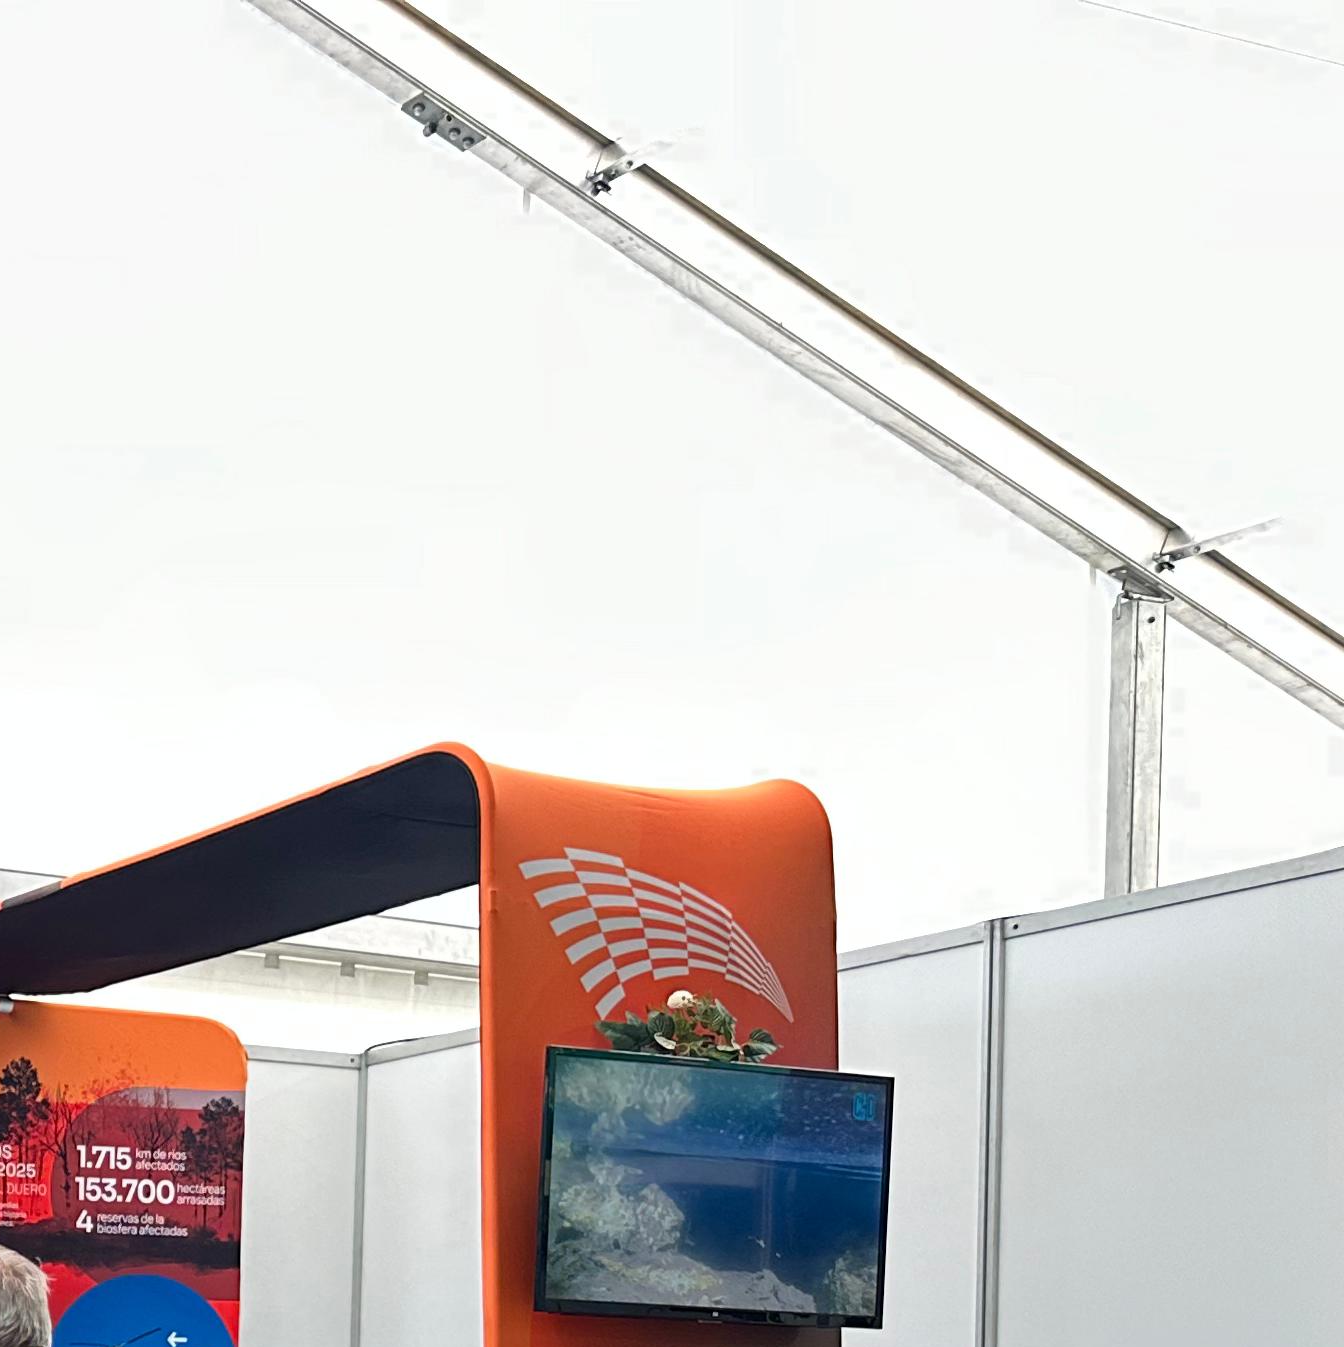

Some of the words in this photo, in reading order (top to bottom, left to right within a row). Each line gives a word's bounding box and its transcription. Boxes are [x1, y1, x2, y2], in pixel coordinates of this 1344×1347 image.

[76, 1145, 131, 1170] 1.715
[135, 1148, 151, 1160] km
[153, 1149, 163, 1160] de
[165, 1149, 186, 1160] ríos
[135, 1159, 185, 1172] afectados
[6, 1182, 47, 1196] DUERO
[75, 1177, 174, 1204] 153.700
[177, 1195, 225, 1205] arrasadas
[76, 1210, 93, 1233] 4
[97, 1213, 138, 1224] reservas
[140, 1214, 153, 1224] de
[155, 1214, 164, 1224] la
[97, 1223, 137, 1236] biosfera
[139, 1224, 188, 1236] afectadas
